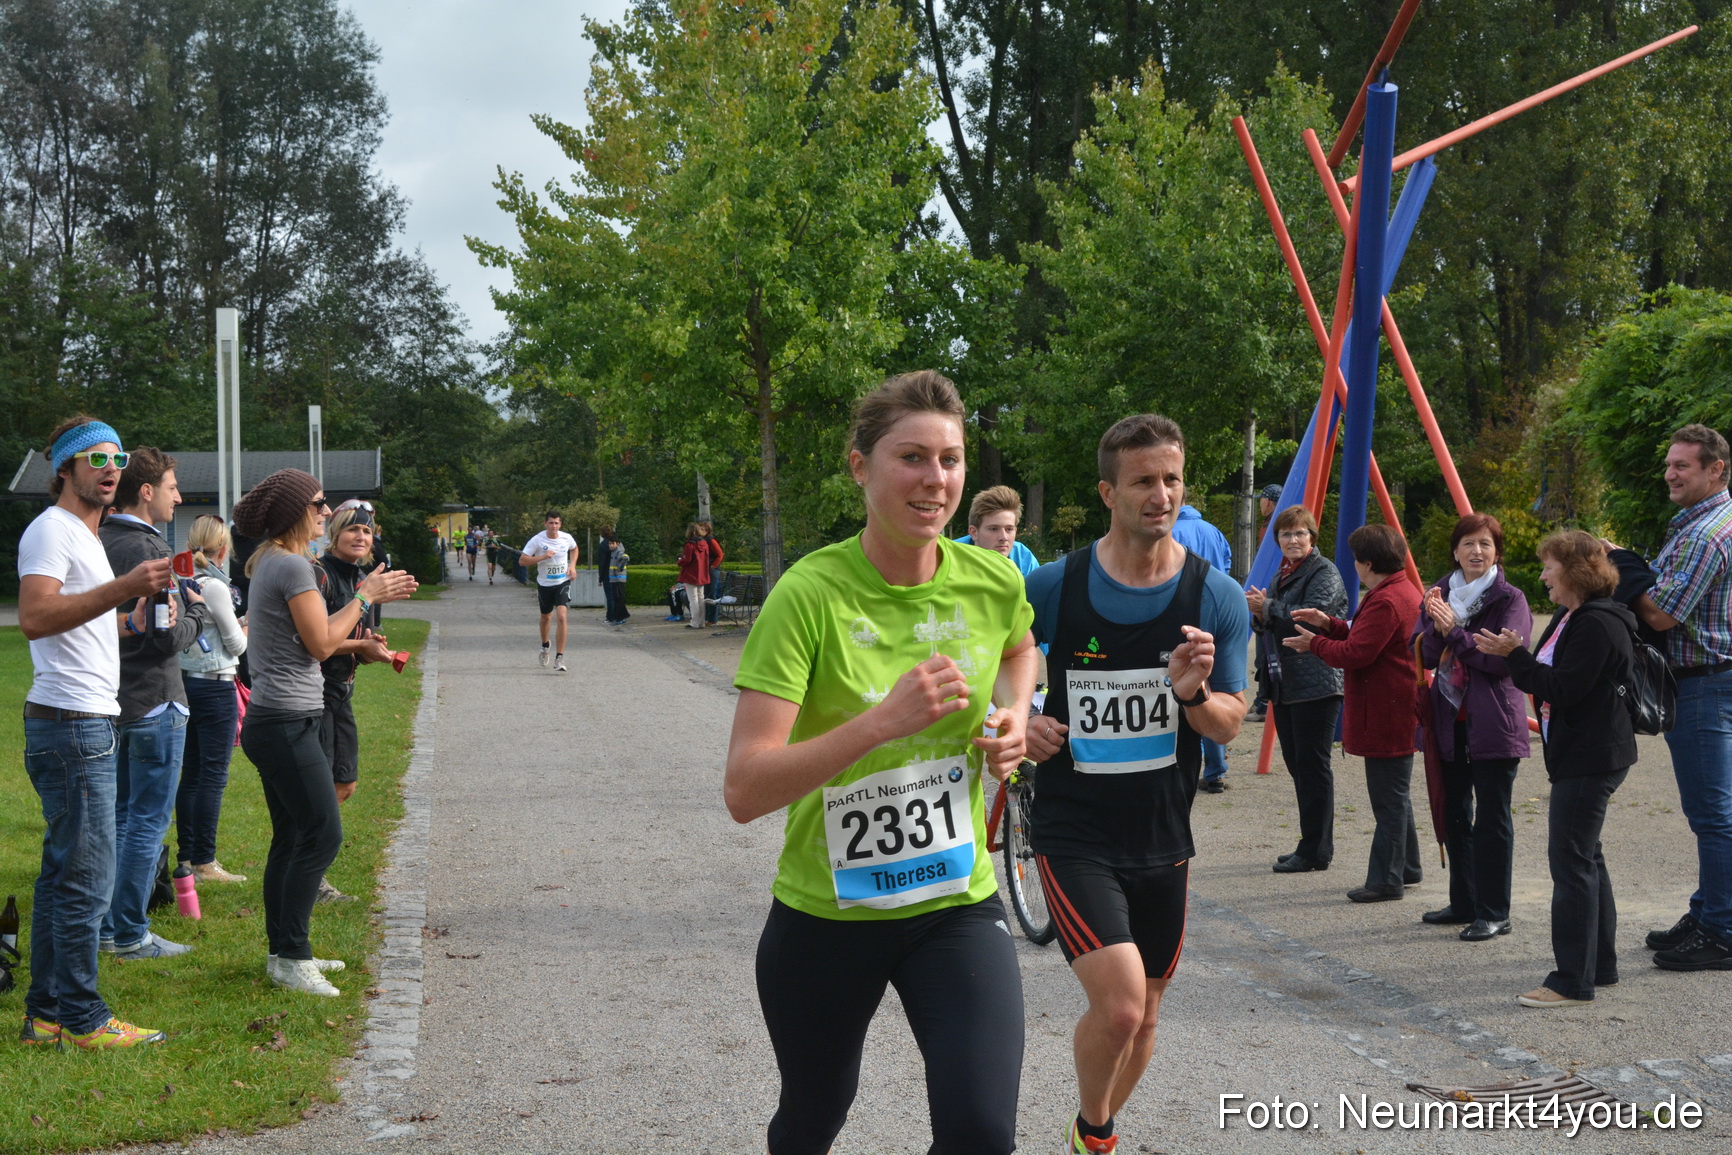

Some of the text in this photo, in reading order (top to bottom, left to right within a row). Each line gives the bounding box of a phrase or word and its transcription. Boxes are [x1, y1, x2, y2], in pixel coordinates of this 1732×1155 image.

[547, 566, 565, 574] 2012
[1069, 679, 1160, 691] PARTL Neumarkt
[1079, 693, 1170, 734] 3404
[827, 773, 943, 811] PARTL Neumarkt
[841, 790, 957, 861] 2331
[871, 862, 947, 891] Theresa
